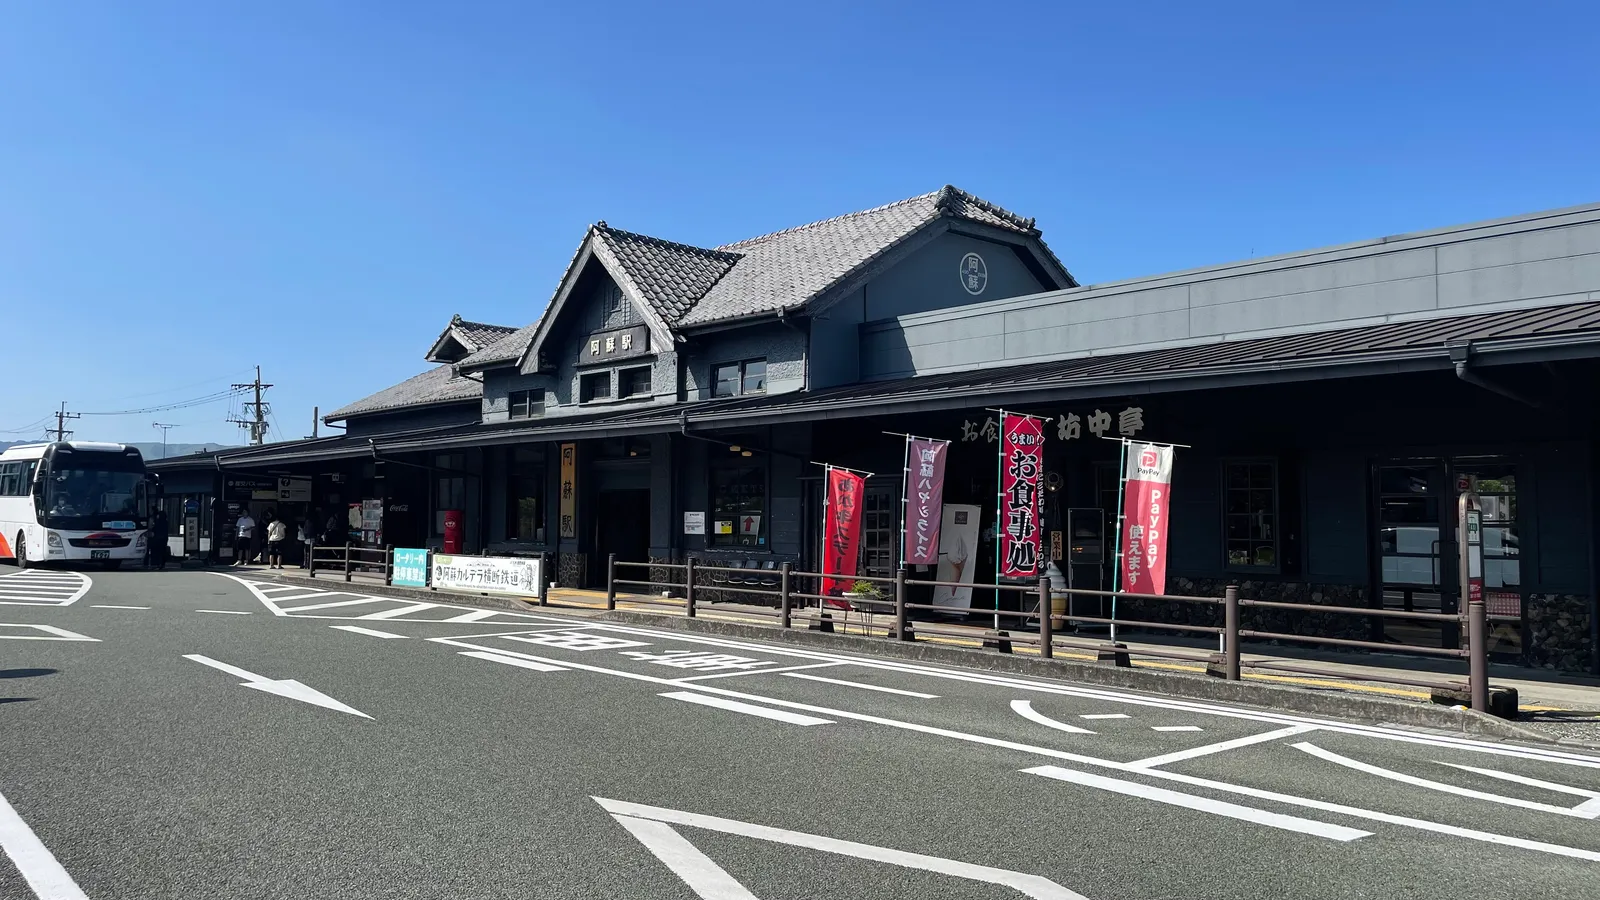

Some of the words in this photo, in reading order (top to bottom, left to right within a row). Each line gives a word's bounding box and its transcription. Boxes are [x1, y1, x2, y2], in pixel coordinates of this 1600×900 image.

[590, 334, 632, 356] 阿蘇駅
[1056, 407, 1145, 441] 坊中亭
[1137, 467, 1160, 477] PayPay
[561, 447, 574, 533] 阿蘇駅
[1007, 449, 1038, 573] お食事処
[1147, 490, 1162, 568] PayPay
[396, 553, 425, 565] ロータリー内
[1128, 525, 1144, 586] 使えます
[394, 566, 425, 582] 駐停車禁止
[443, 566, 519, 586] 阿蘇カルデラ横断鉄道
